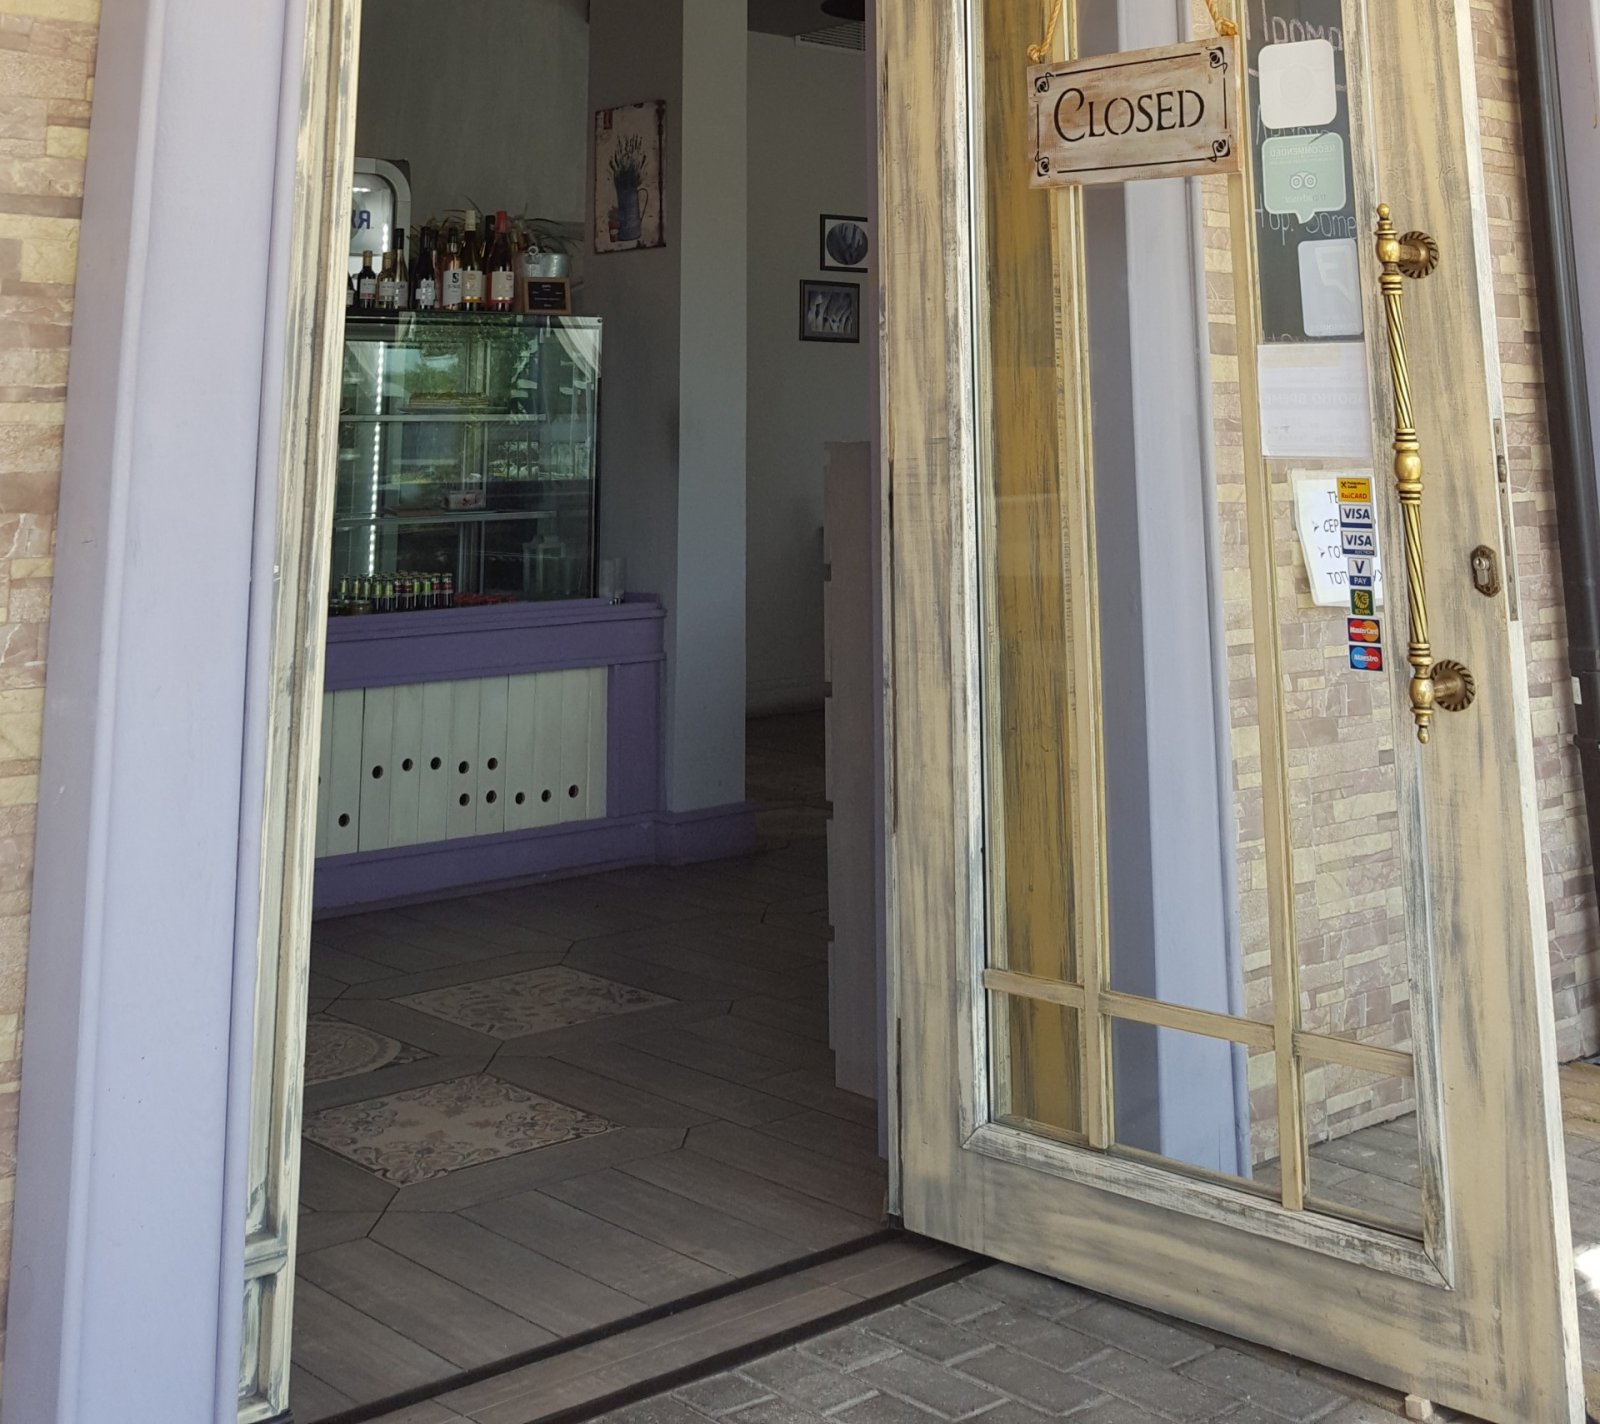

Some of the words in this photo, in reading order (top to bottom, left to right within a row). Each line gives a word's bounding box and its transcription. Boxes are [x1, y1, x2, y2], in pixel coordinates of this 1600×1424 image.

[1053, 87, 1205, 142] CLOSED
[1343, 508, 1371, 520] VISA
[1346, 535, 1372, 547] VISA
[1353, 560, 1365, 574] V
[1354, 577, 1367, 585] PAY
[1349, 626, 1378, 636] MasterCard
[1353, 654, 1378, 663] Maestro
